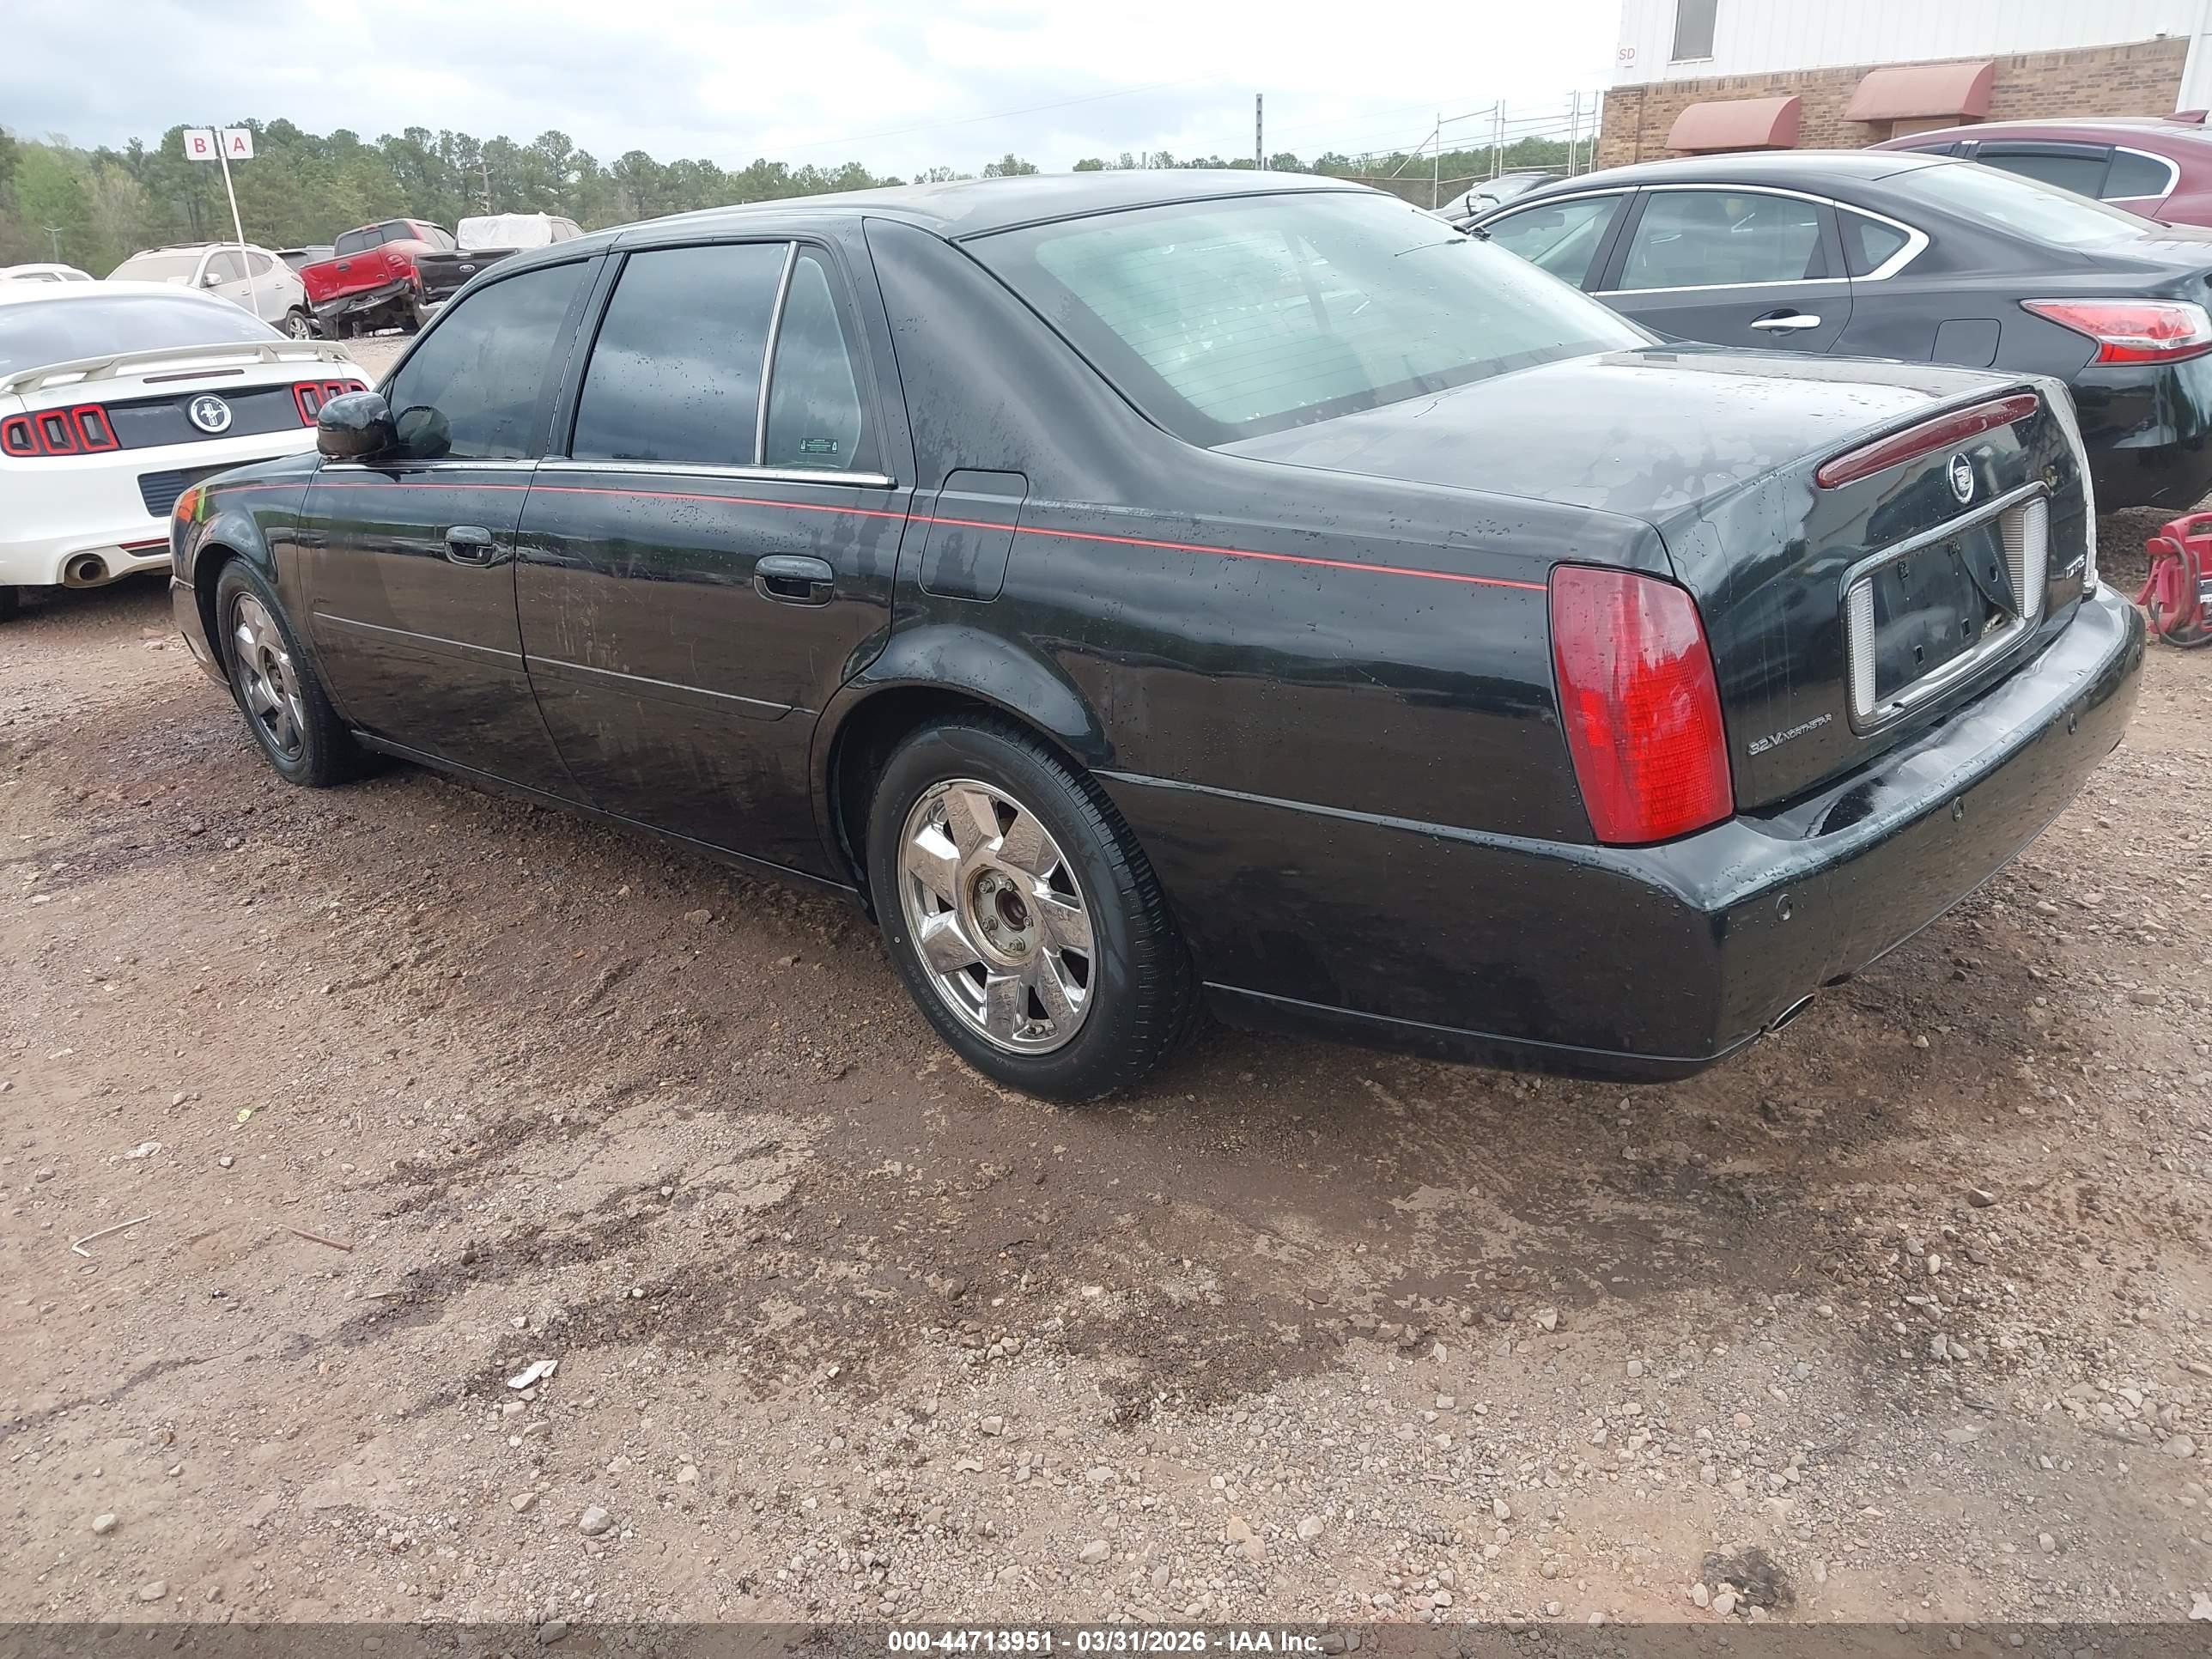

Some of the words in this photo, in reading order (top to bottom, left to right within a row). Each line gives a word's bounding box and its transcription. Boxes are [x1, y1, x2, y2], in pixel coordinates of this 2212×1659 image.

[1619, 48, 1635, 60] SD
[193, 137, 207, 153] B
[234, 137, 246, 152] A
